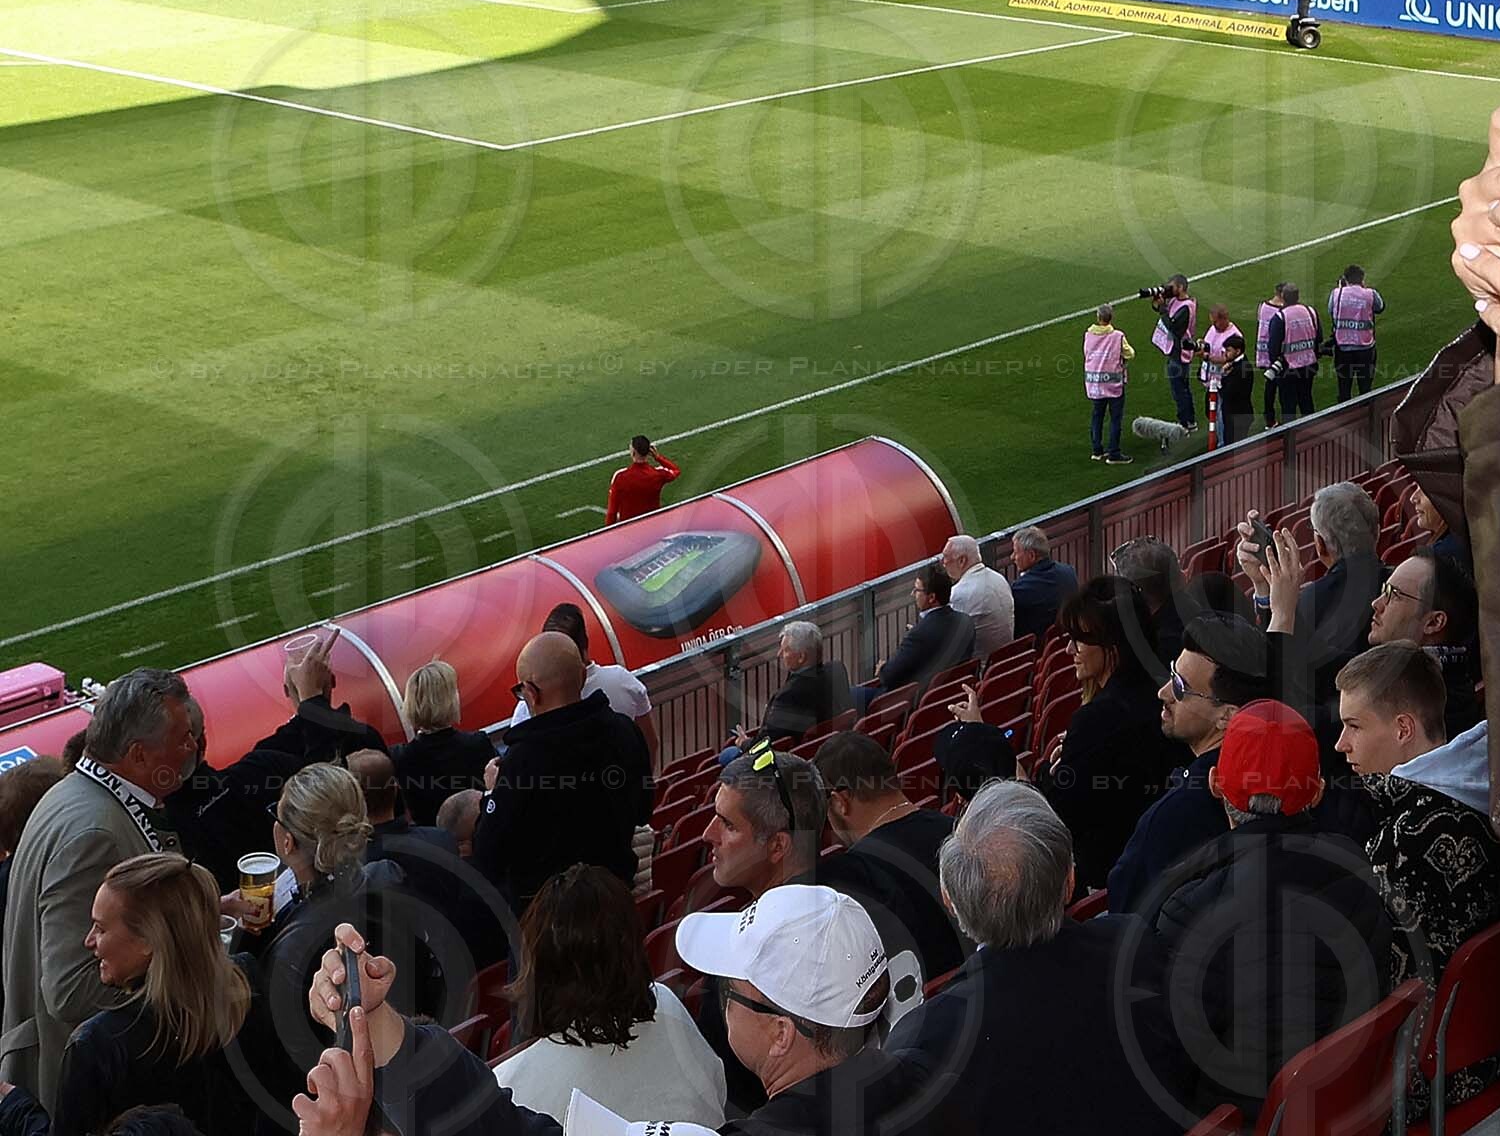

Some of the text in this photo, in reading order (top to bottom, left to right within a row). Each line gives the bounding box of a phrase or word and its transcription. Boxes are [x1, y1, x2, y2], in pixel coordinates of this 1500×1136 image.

[1063, 0, 1113, 15] ADMIRAL
[1117, 7, 1169, 23] ADMIRAL
[1170, 14, 1224, 31] ADMIRAL
[1226, 21, 1280, 38] ADMIRAL
